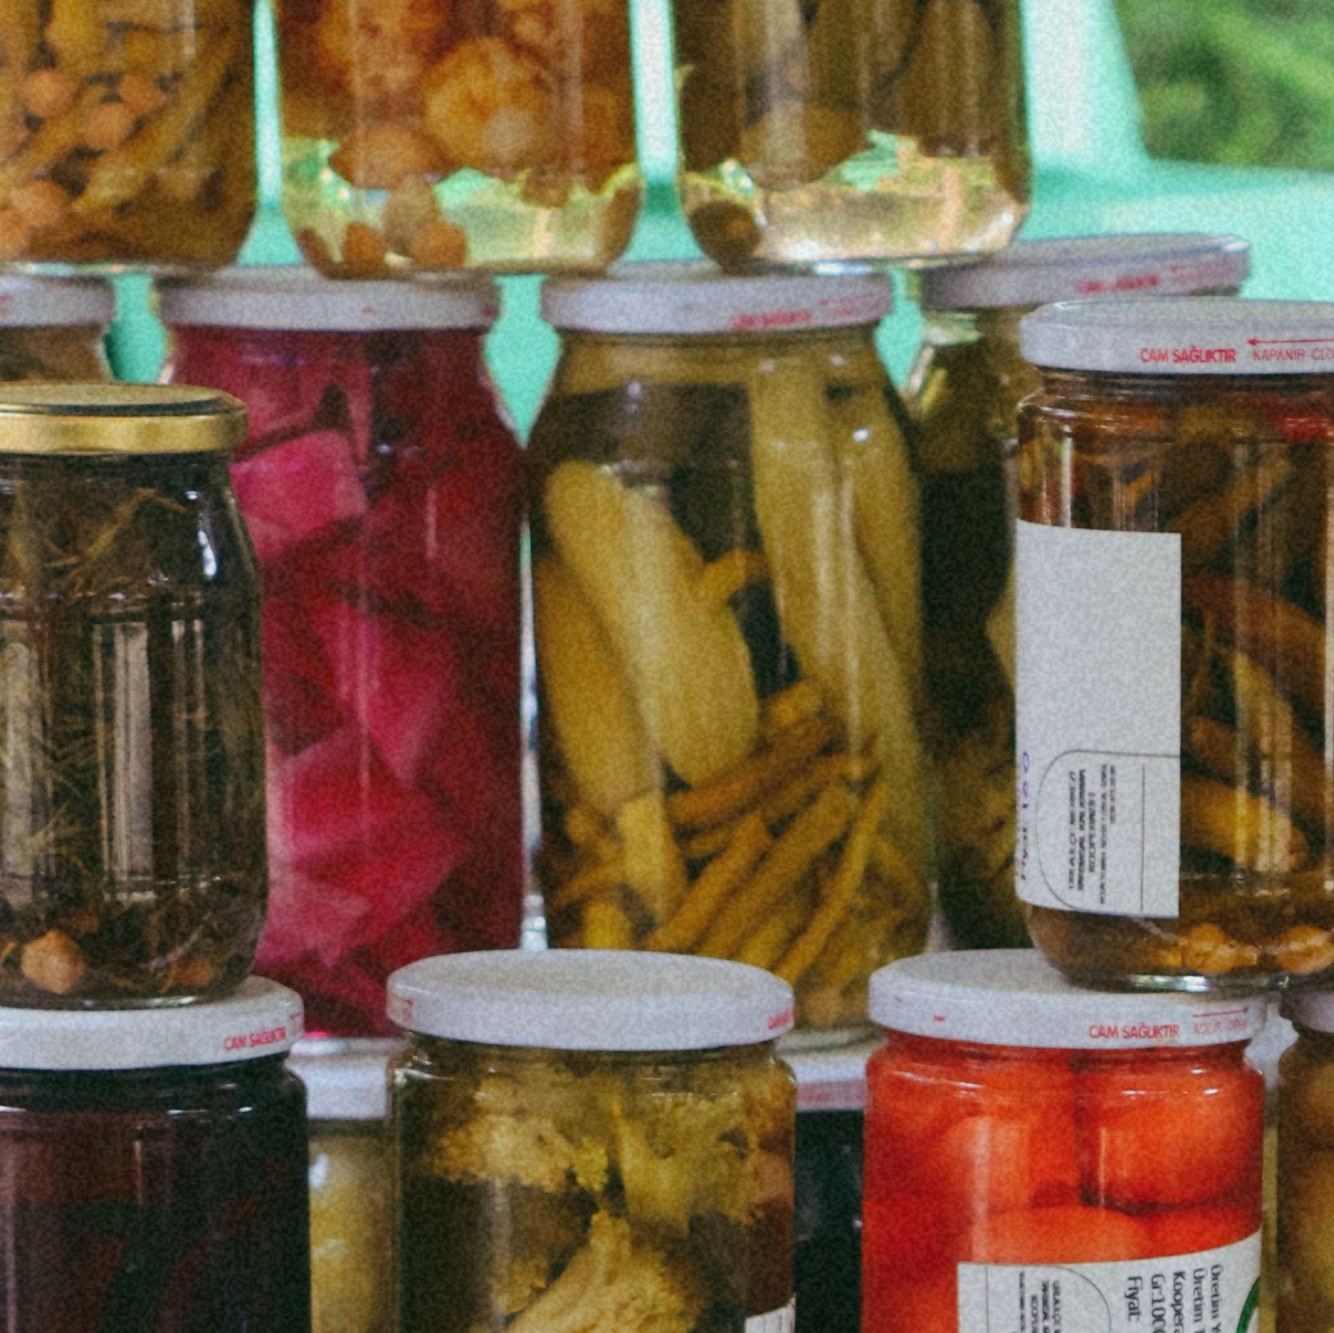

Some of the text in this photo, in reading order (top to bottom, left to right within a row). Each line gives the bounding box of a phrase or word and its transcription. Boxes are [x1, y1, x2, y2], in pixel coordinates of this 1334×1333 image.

[1139, 348, 1169, 363] CAM
[1089, 1024, 1119, 1039] CAM
[1123, 1275, 1144, 1322] Fiyat:
[1191, 1267, 1207, 1329] Üretim
